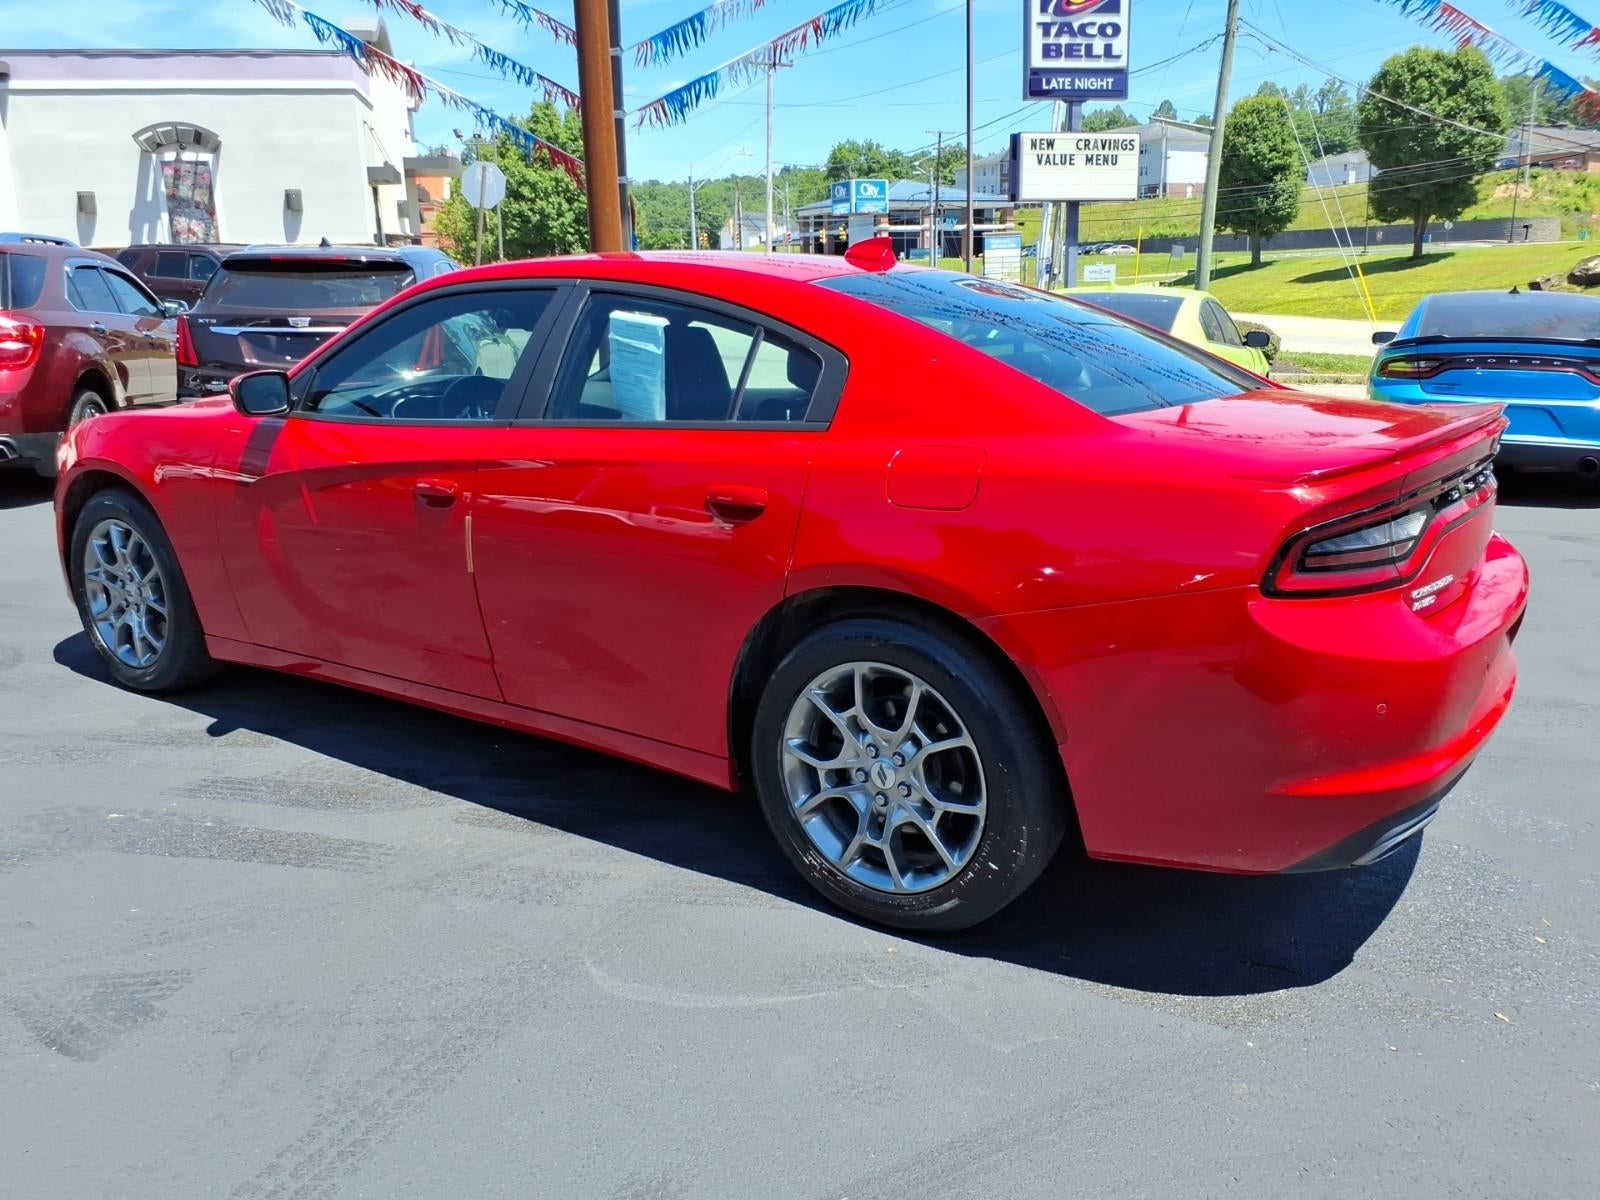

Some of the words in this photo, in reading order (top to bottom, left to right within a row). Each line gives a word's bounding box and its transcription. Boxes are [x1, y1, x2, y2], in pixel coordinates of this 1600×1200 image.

[1036, 22, 1122, 39] TACO
[1042, 43, 1122, 60] BELL
[1042, 78, 1071, 90] LATE
[1075, 78, 1114, 90] NIGHT
[1030, 138, 1056, 151] NEW
[1076, 138, 1136, 151] CRAVINGS
[1036, 154, 1076, 166] VALUE
[1085, 154, 1118, 166] MENU
[860, 183, 880, 198] City
